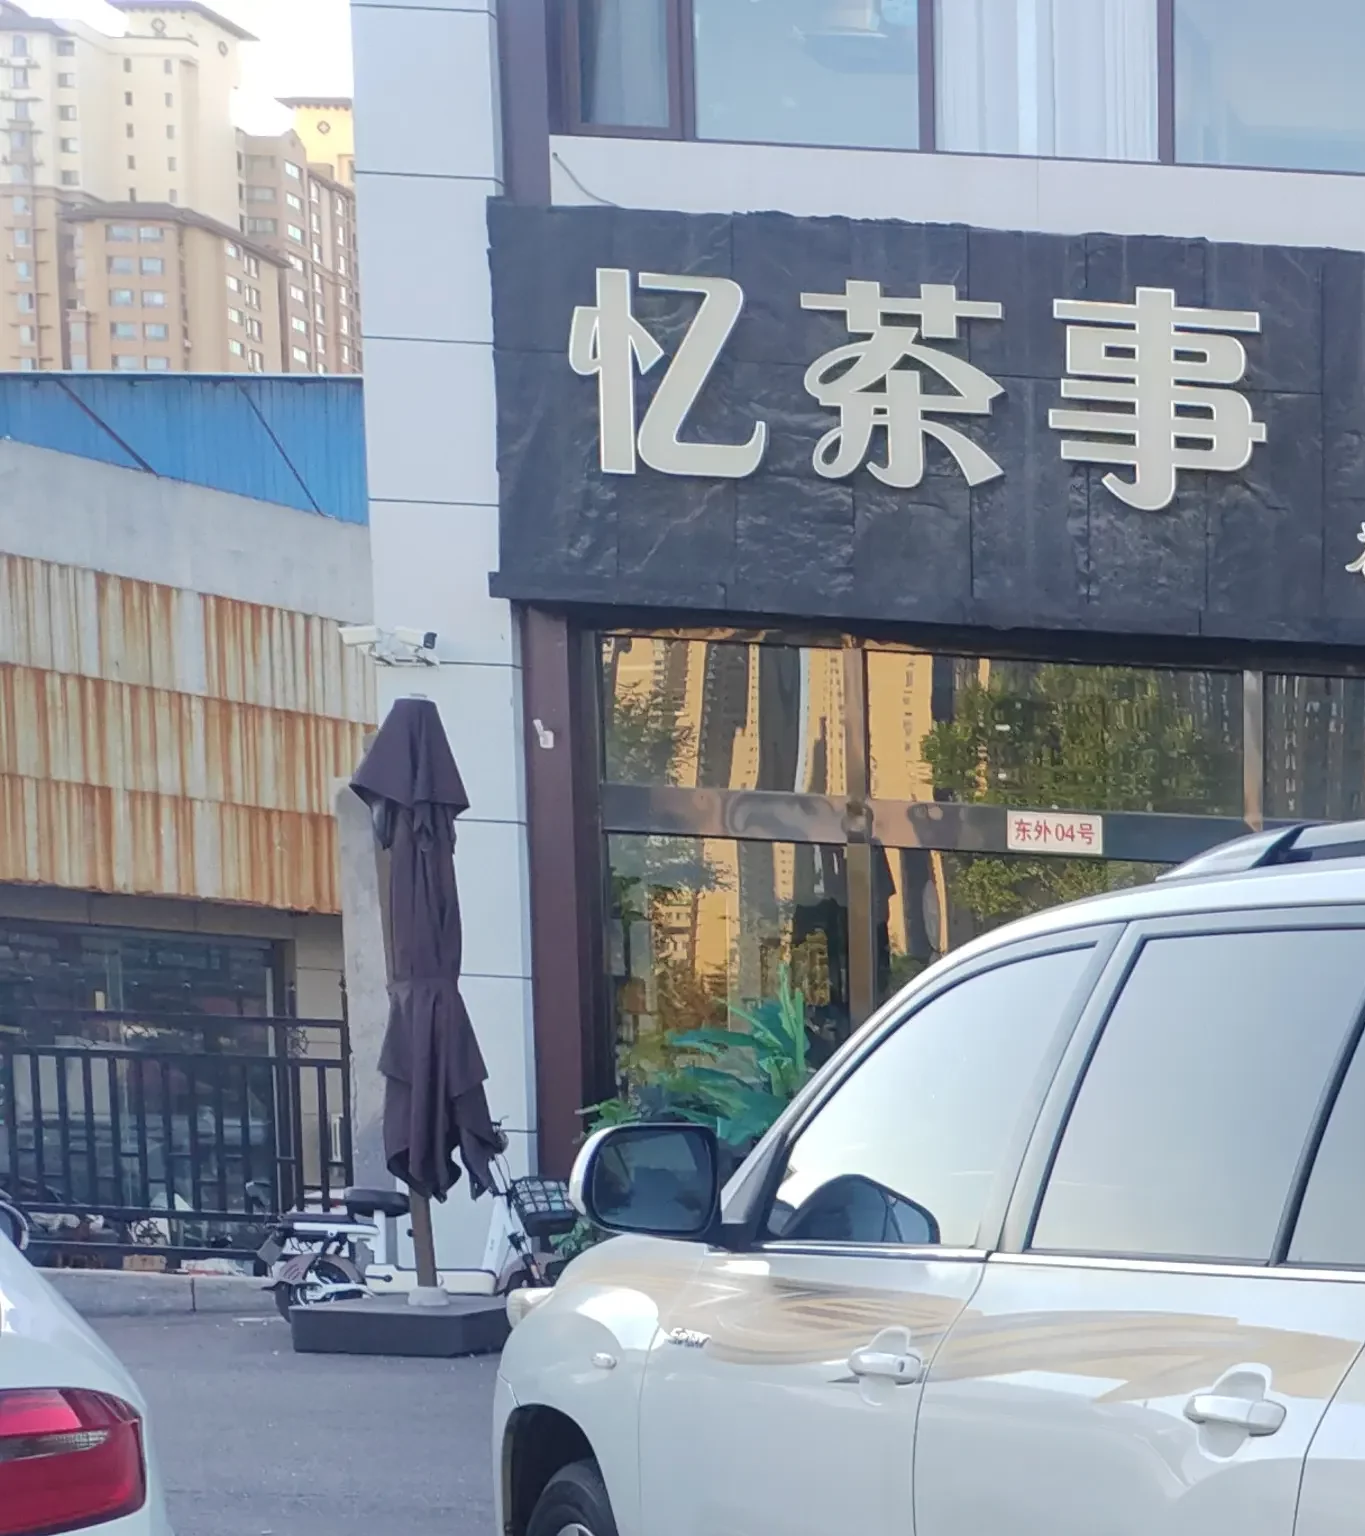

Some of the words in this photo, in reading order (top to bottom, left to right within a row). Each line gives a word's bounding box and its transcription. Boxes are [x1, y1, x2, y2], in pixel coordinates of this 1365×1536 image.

[568, 267, 1267, 512] 忆茶事
[1015, 818, 1095, 845] 东外04号
